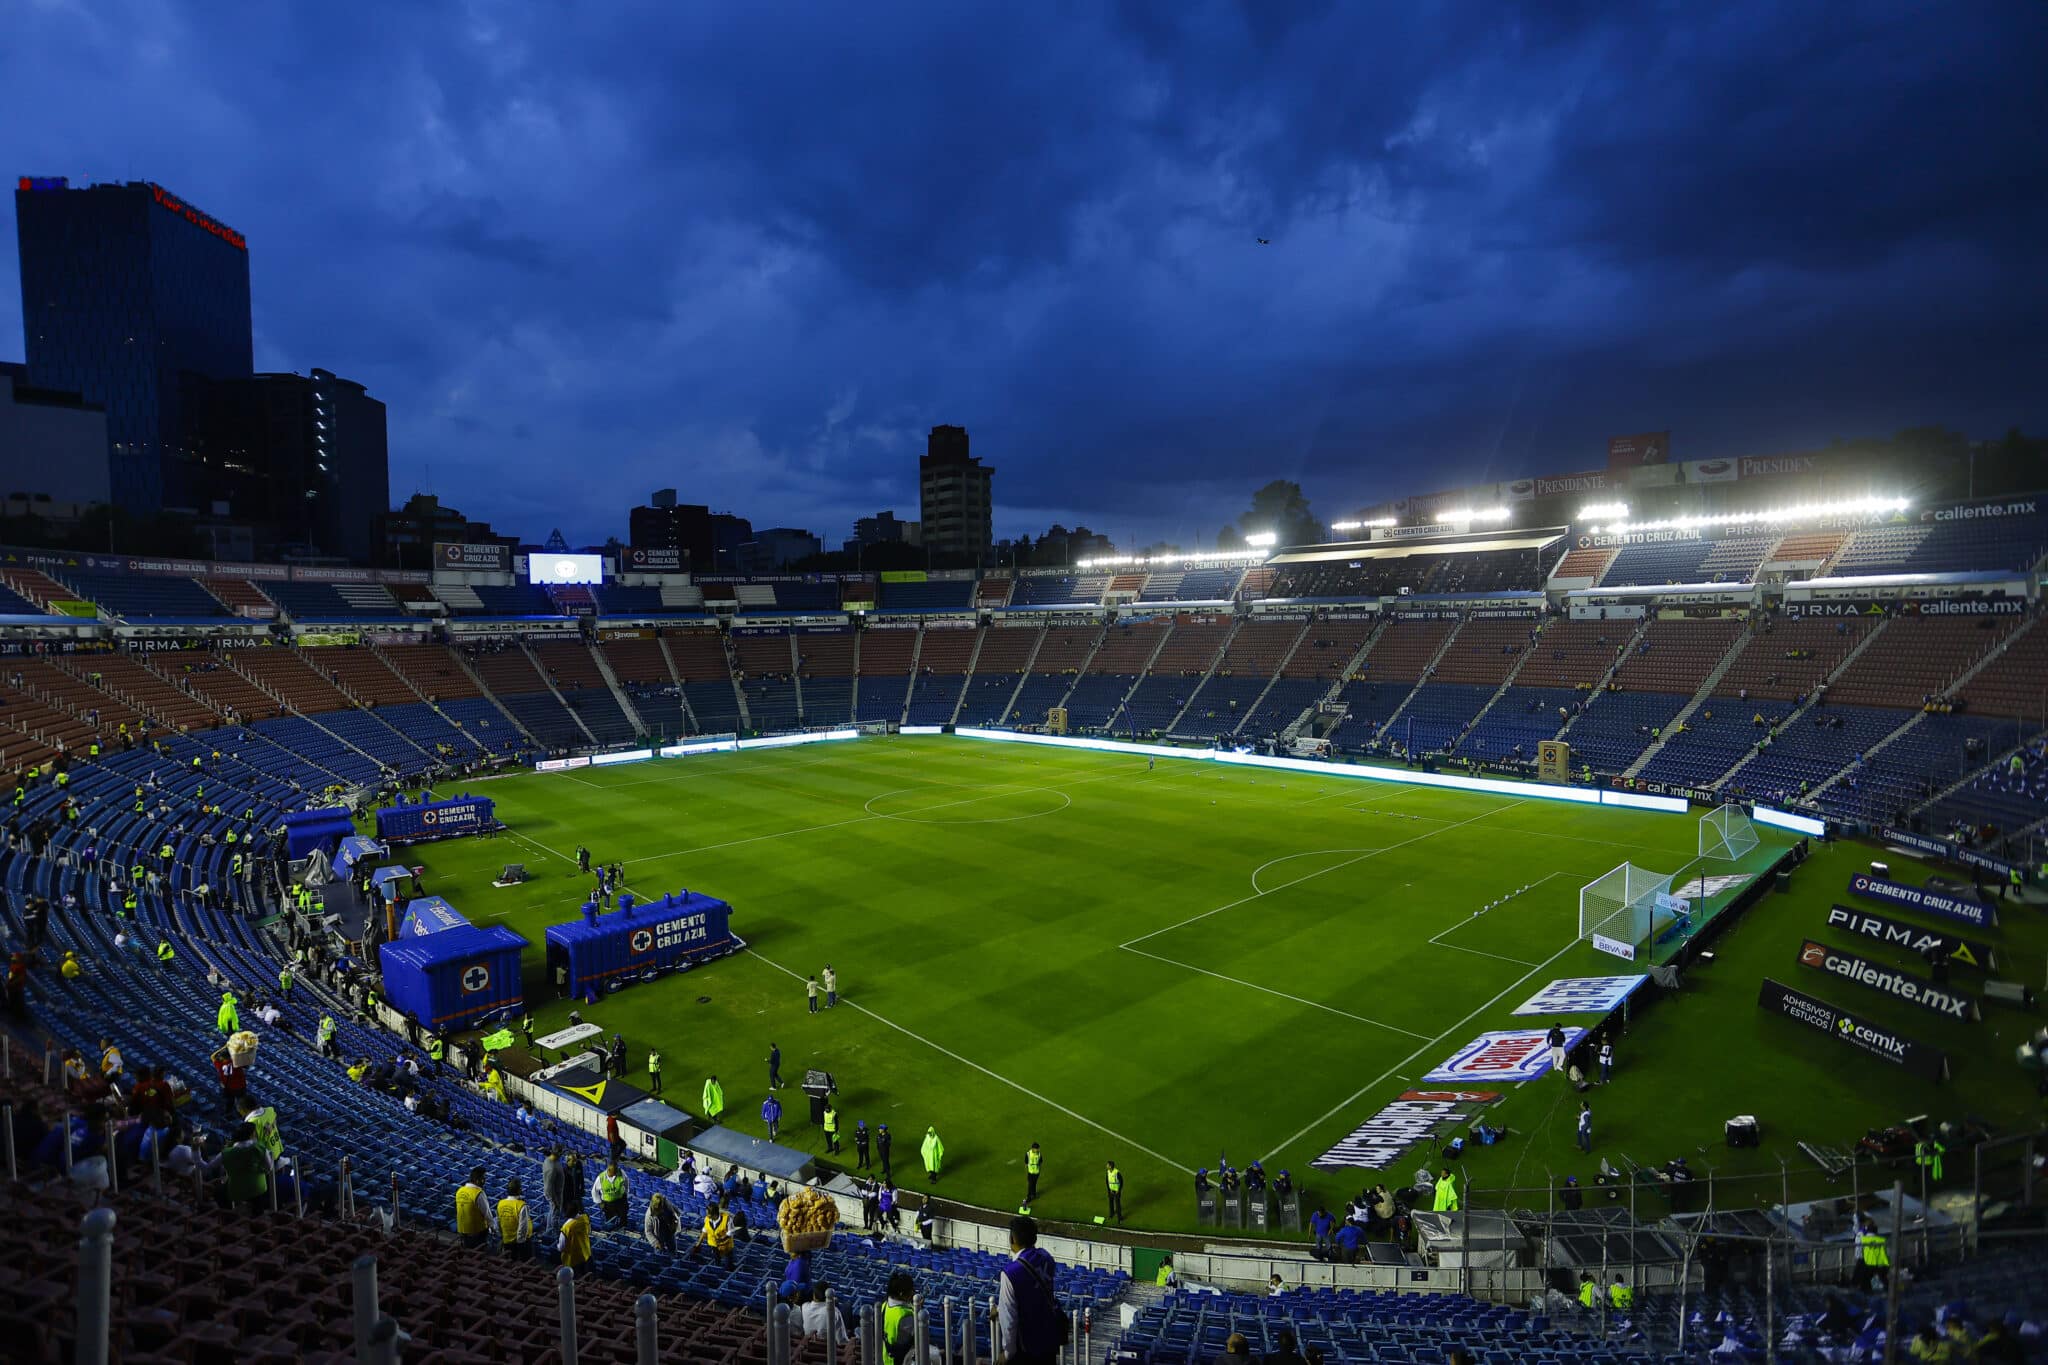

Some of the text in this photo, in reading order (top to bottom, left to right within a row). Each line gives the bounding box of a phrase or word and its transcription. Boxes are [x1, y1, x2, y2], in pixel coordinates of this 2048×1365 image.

[1934, 502, 2036, 520] caliente.mx
[1393, 527, 1423, 537] CEMENTO
[1423, 525, 1439, 535] CRUZ
[1726, 525, 1781, 537] PIRMA
[1594, 528, 1702, 547] CEMENTO CRUZ AZUL
[464, 545, 500, 554] CEMENTO
[648, 549, 679, 557] CEMENTO
[27, 555, 65, 566] PIRMA
[464, 554, 500, 562] CRUZ AZUL
[139, 562, 207, 573] CEMENTO CRUZ AZUL
[222, 566, 253, 574] CEMENTO
[1195, 560, 1228, 570] CEMENTO
[1229, 559, 1246, 568] CRUZ
[1027, 568, 1070, 578] caliente.mx
[1787, 604, 1860, 617] PIRMA
[1919, 597, 2025, 615] caliente.mx
[1478, 611, 1506, 619] CEMENTO
[1507, 610, 1523, 618] CRUZ
[1050, 619, 1087, 627] PIRMA
[128, 639, 180, 651] PIRMA
[439, 805, 476, 816] CEMENTO
[440, 812, 476, 824] CRUZ AZUL
[1891, 831, 1948, 856] CEMENTO CRUZ AZUL
[1867, 879, 1984, 921] CEMENTO CRUZ AZUL
[655, 912, 707, 936] CEMENTO
[1827, 908, 1942, 952] PIRMA
[656, 926, 708, 950] CRUZ AZUL
[1824, 954, 1969, 1018] caliente.mx
[1782, 994, 1832, 1021] ADHESIVOS
[1790, 1006, 1830, 1031] ESTUCOS
[1853, 1023, 1906, 1058] cemix
[1461, 1037, 1545, 1071] BIMBO
